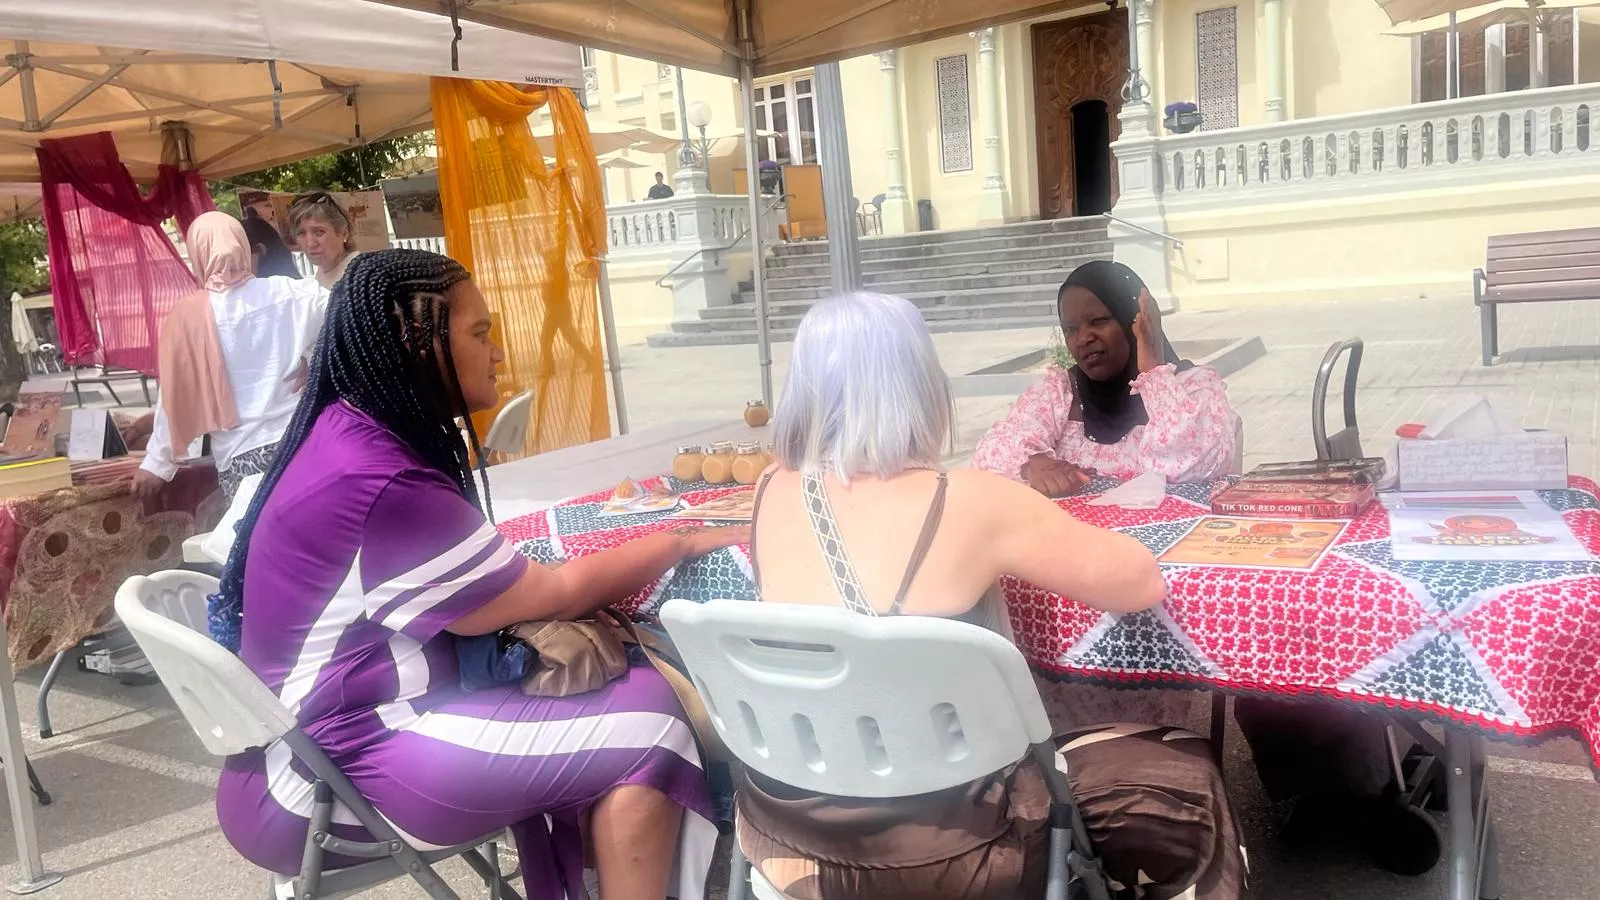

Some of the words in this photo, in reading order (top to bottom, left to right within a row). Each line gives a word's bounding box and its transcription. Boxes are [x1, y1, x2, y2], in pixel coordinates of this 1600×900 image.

[525, 76, 563, 84] MASTERTENT
[1221, 503, 1236, 511] TIK
[1238, 504, 1256, 512] TOK
[1258, 504, 1276, 512] RED
